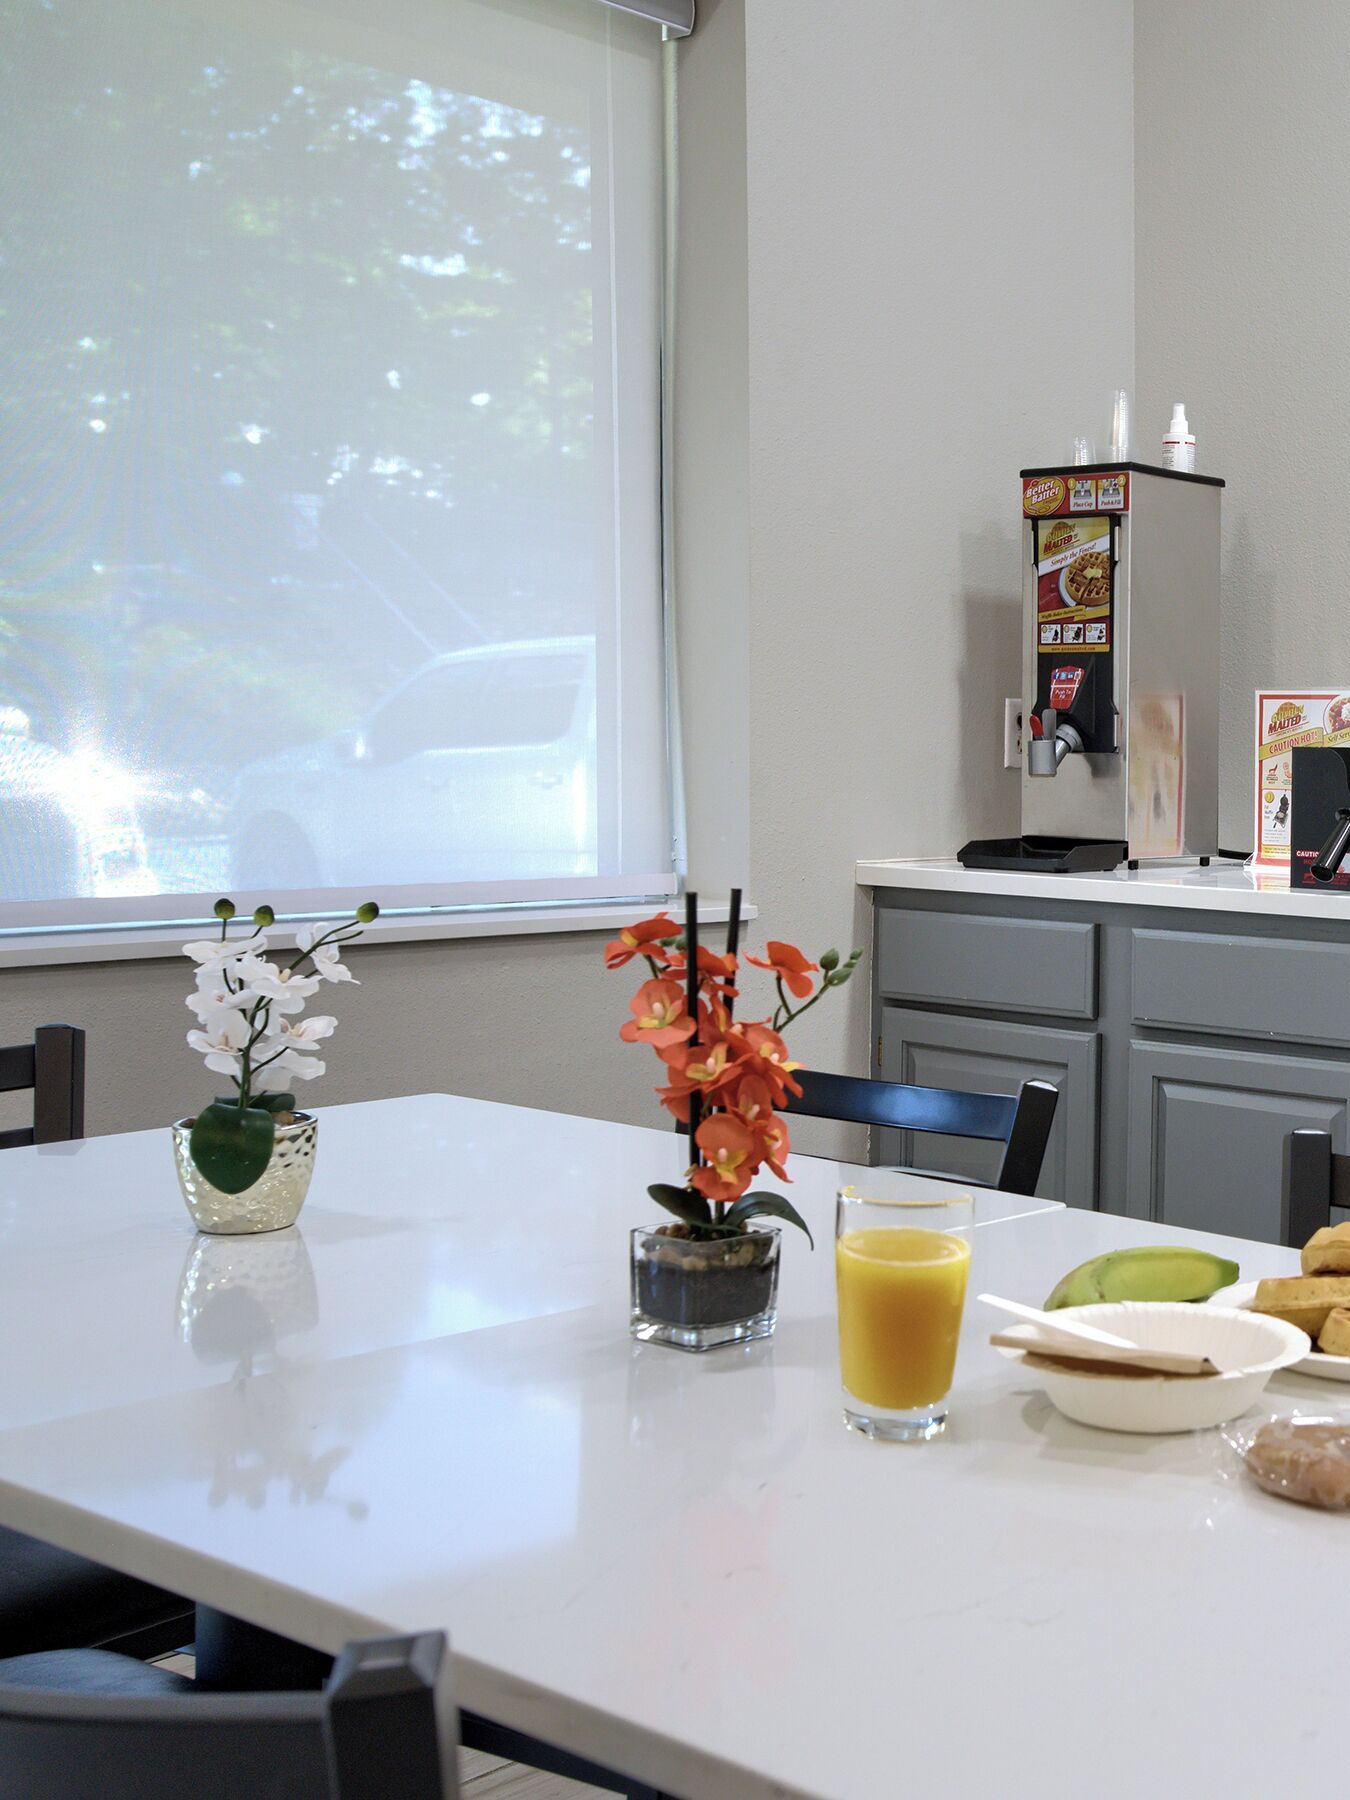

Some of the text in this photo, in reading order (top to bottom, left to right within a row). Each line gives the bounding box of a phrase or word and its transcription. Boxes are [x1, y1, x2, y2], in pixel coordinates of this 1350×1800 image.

[1026, 480, 1055, 499] Better
[1032, 486, 1060, 504] Batter
[1084, 500, 1093, 508] Cup
[1044, 534, 1073, 553] MALTED
[1050, 554, 1069, 567] Simply
[1069, 550, 1079, 559] the
[1079, 542, 1097, 554] Finest!
[1268, 713, 1302, 734] MALTED
[1269, 737, 1300, 754] CAUTION
[1300, 730, 1318, 744] HOT!
[1328, 733, 1339, 743] Self
